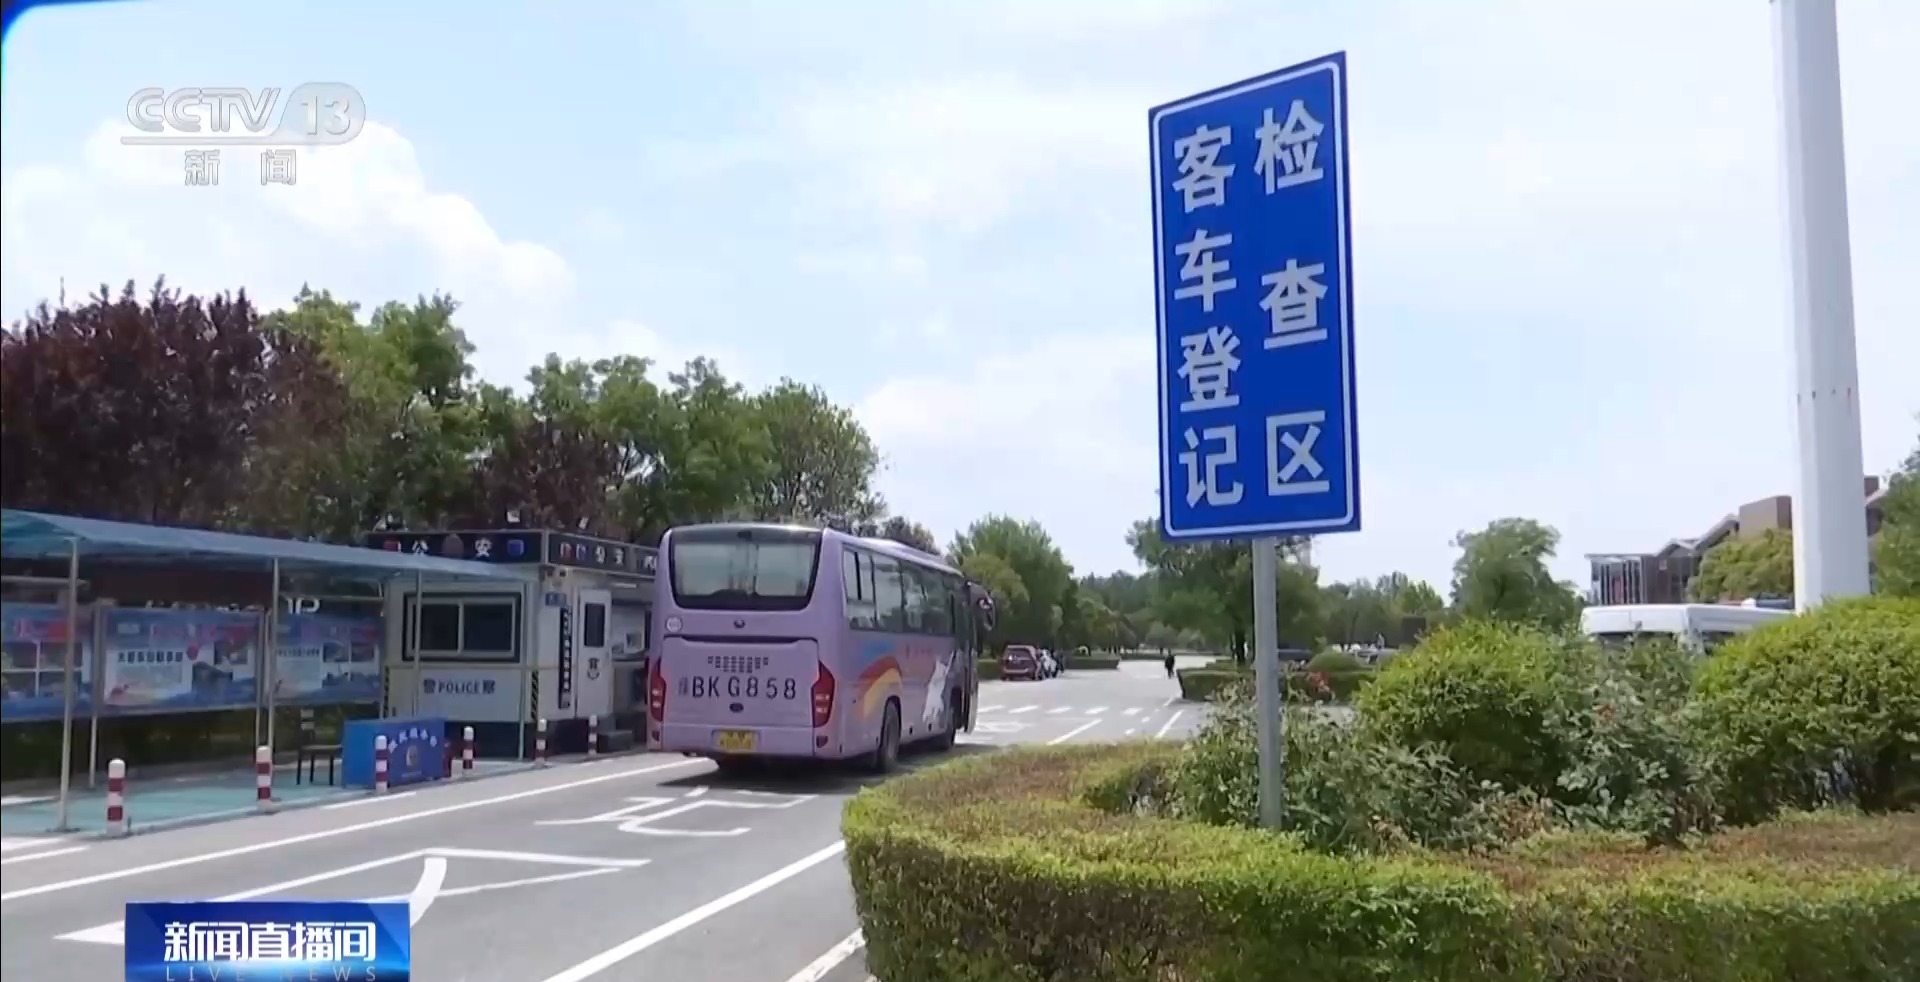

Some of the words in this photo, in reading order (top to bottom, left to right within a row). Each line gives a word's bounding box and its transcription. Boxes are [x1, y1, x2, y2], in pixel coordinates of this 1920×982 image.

[1172, 124, 1244, 508] 客车登记
[1254, 99, 1330, 496] 检查区
